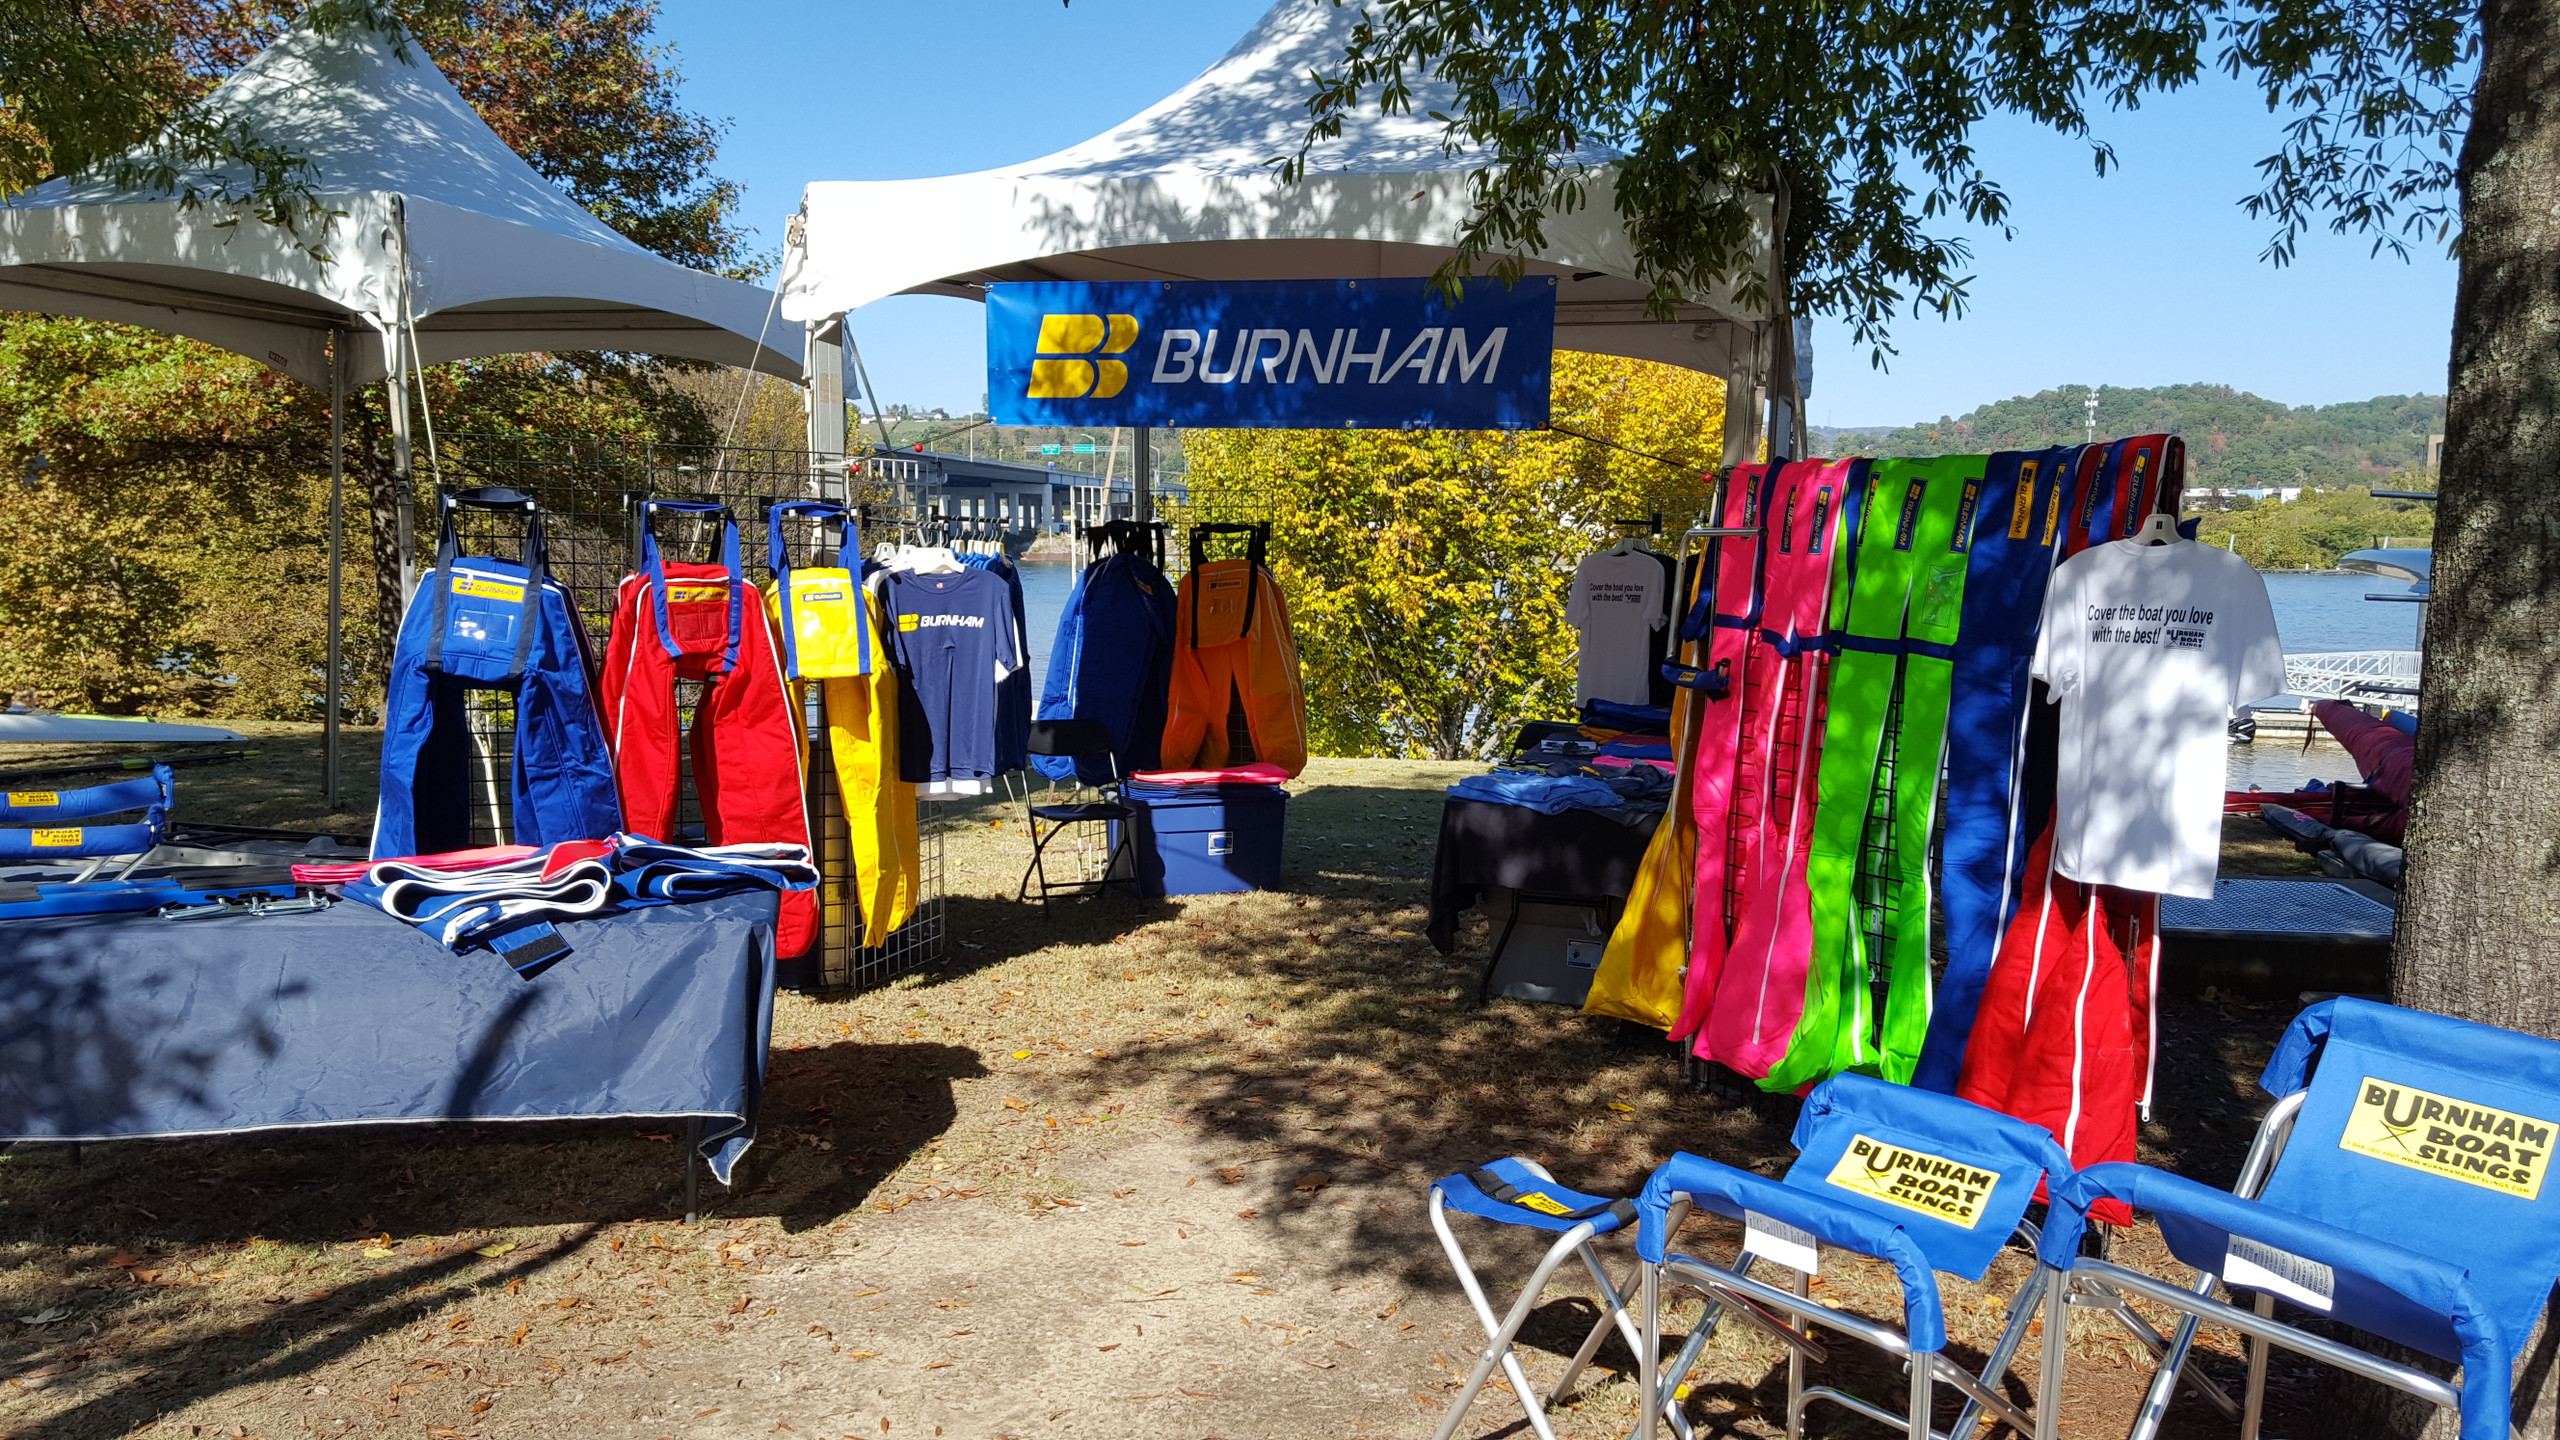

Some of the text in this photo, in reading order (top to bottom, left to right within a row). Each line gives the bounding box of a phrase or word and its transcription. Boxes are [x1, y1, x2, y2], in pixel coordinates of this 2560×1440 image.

[1151, 327, 1508, 385] BURNHAM
[1899, 499, 1915, 546] BURNHAM
[2015, 485, 2028, 534] BURNHAM
[2125, 475, 2140, 530] BURNHAM
[1812, 506, 1824, 550] BURNHAM
[1955, 501, 1971, 548] BURNHAM
[1604, 583, 1612, 591] the
[1624, 585, 1633, 593] you
[920, 614, 984, 629] BURNHAM
[2088, 604, 2213, 626] Cover the boat you love
[2092, 626, 2162, 644] with the best!
[2364, 1083, 2549, 1149] BURNHAM
[1853, 1140, 1991, 1190] BURNHAM
[2416, 1144, 2531, 1185] SLINGS
[2426, 1125, 2541, 1167] BOAT
[1887, 1185, 1973, 1217] SLINGS
[1896, 1173, 1983, 1204] BOAT
